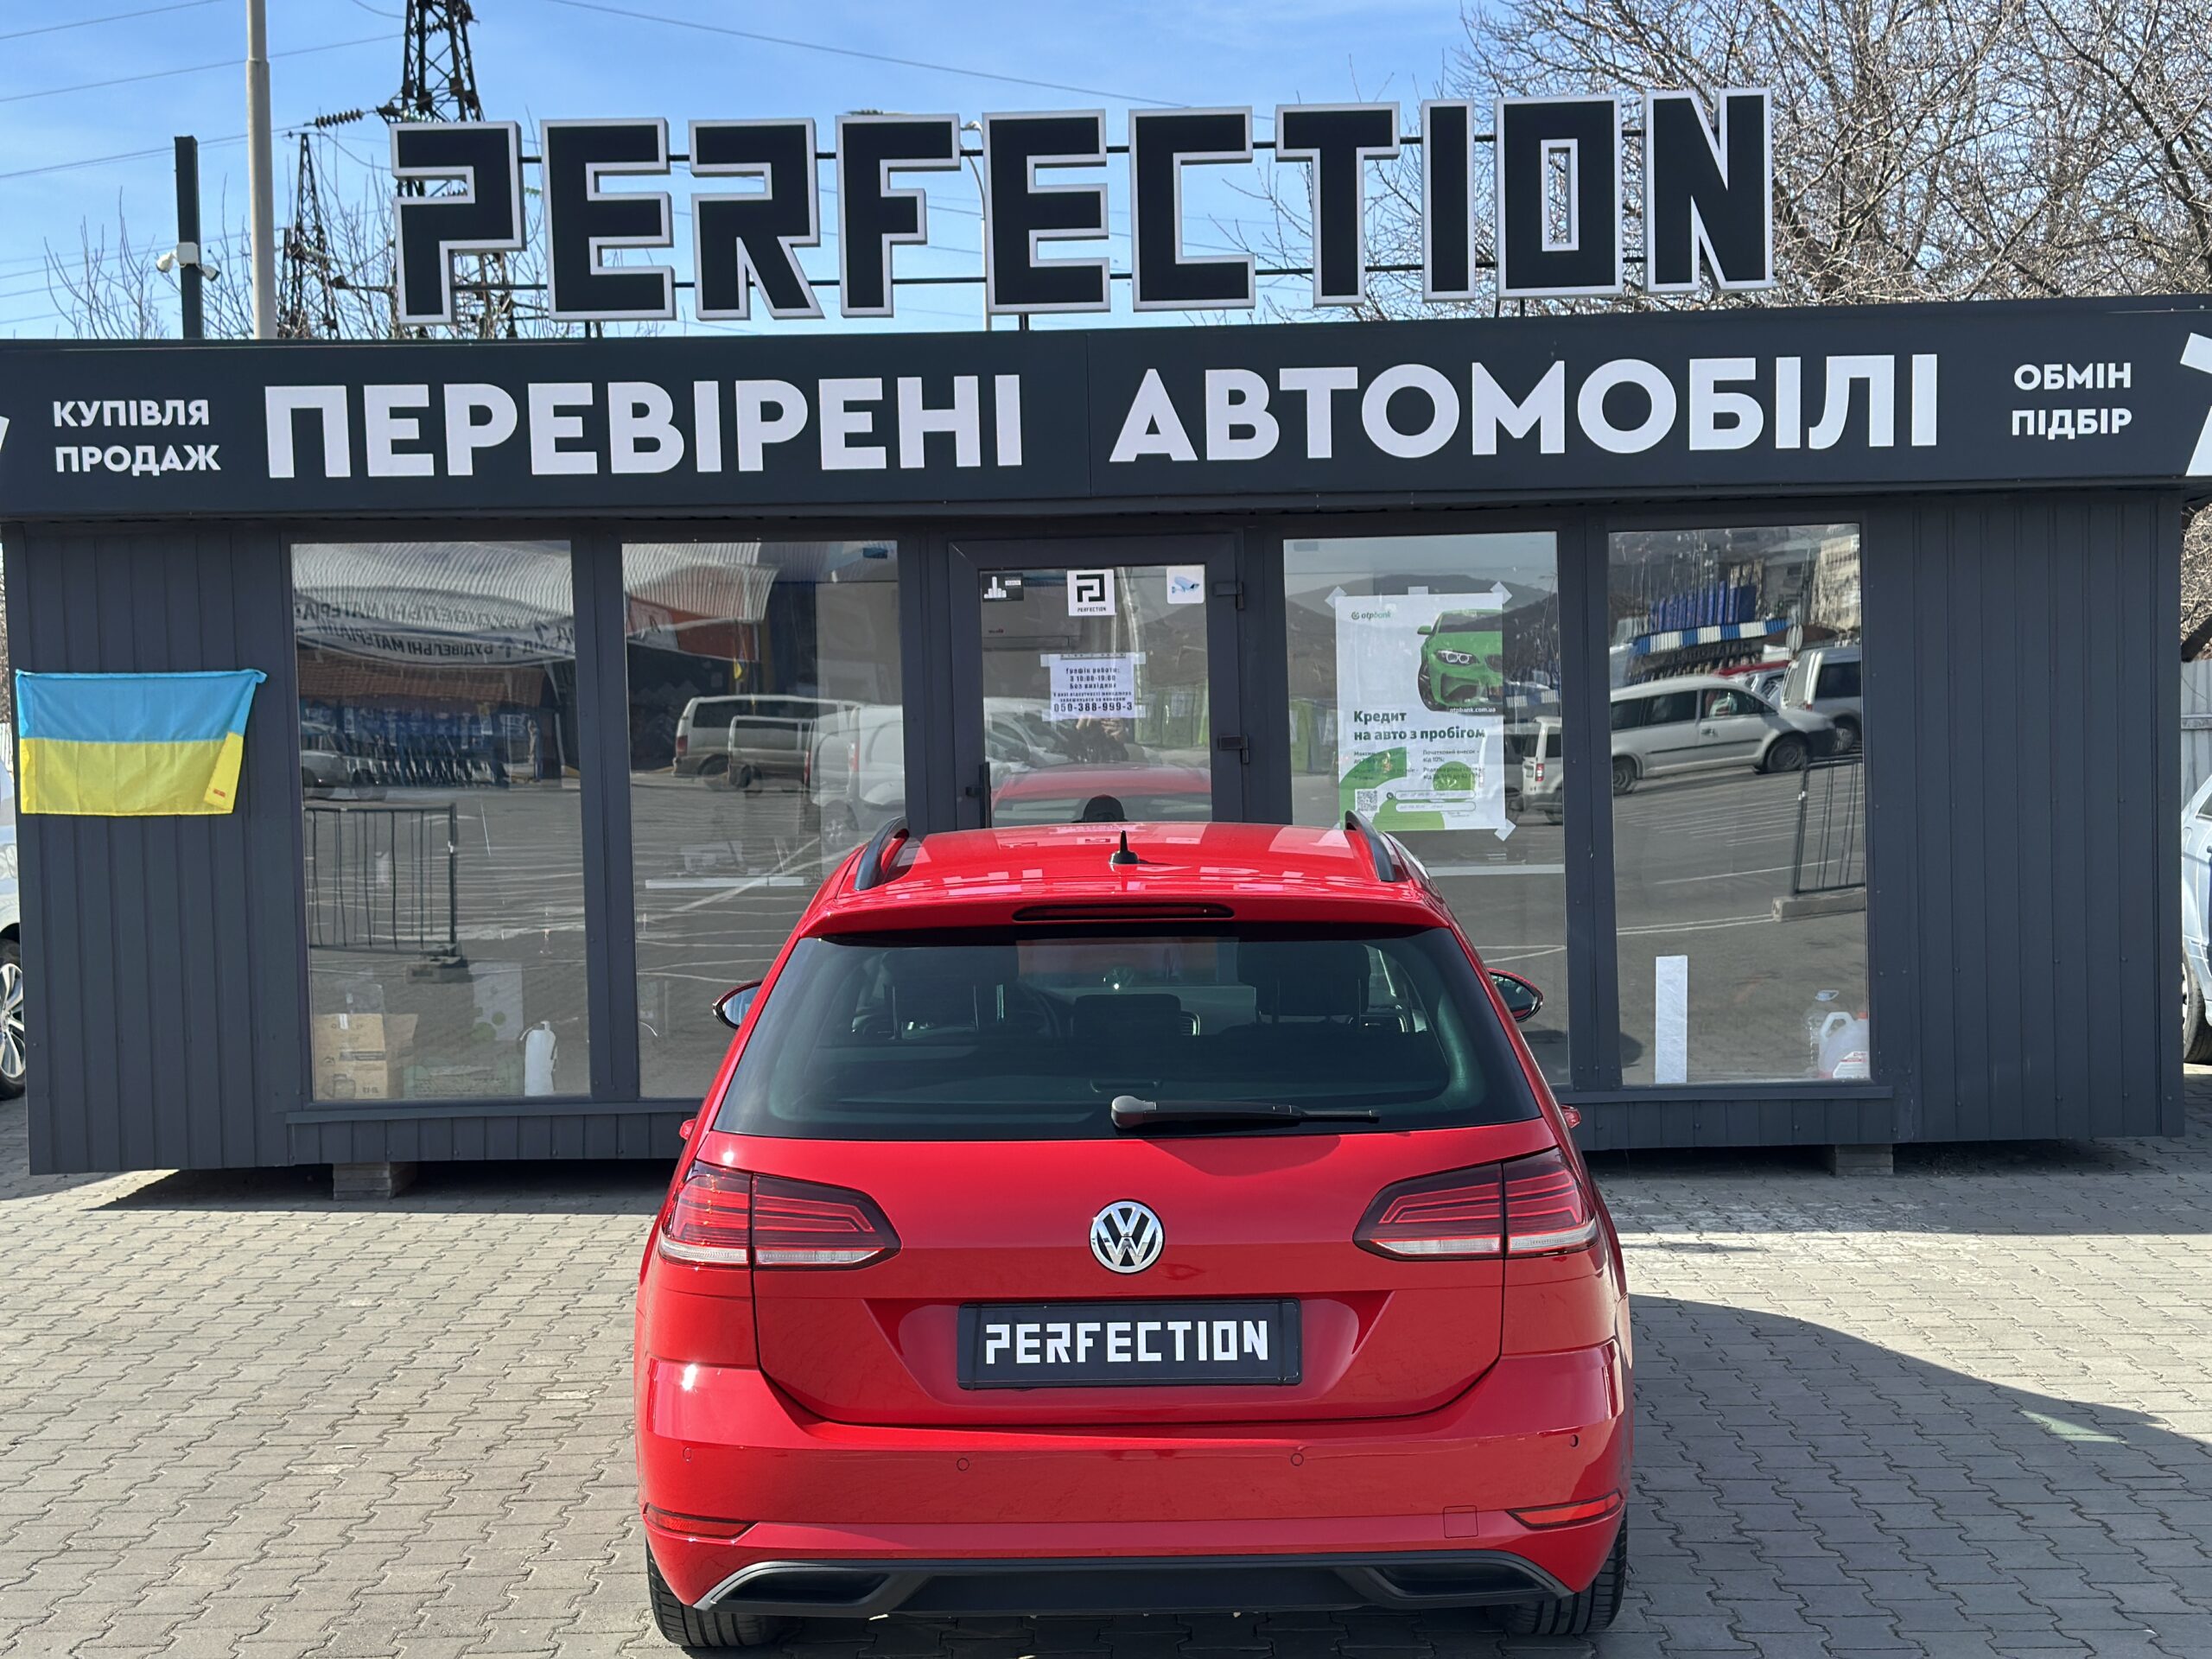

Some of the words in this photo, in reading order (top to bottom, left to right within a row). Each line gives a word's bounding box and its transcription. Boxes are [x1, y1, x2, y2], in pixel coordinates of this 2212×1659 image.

[390, 86, 1774, 326] PERFECTION
[2013, 362, 2132, 391] ОБМІН
[53, 399, 210, 428] КУПІВЛЯ
[264, 373, 1022, 479] ПЕРЕВІРЕНІ
[1109, 354, 1938, 463] АВТОМОБІЛІ
[2012, 408, 2133, 441] ПІДБІР
[55, 444, 221, 476] ПРОДАЖ
[1361, 610, 1391, 621] otpbank
[1053, 702, 1133, 713] 050-388-999-3
[1353, 710, 1407, 724] Кредит
[1354, 731, 1371, 741] на
[1375, 730, 1408, 741] авто
[1409, 730, 1417, 740] з
[1420, 726, 1486, 742] пробігом
[985, 1319, 1268, 1364] PERFECTION
